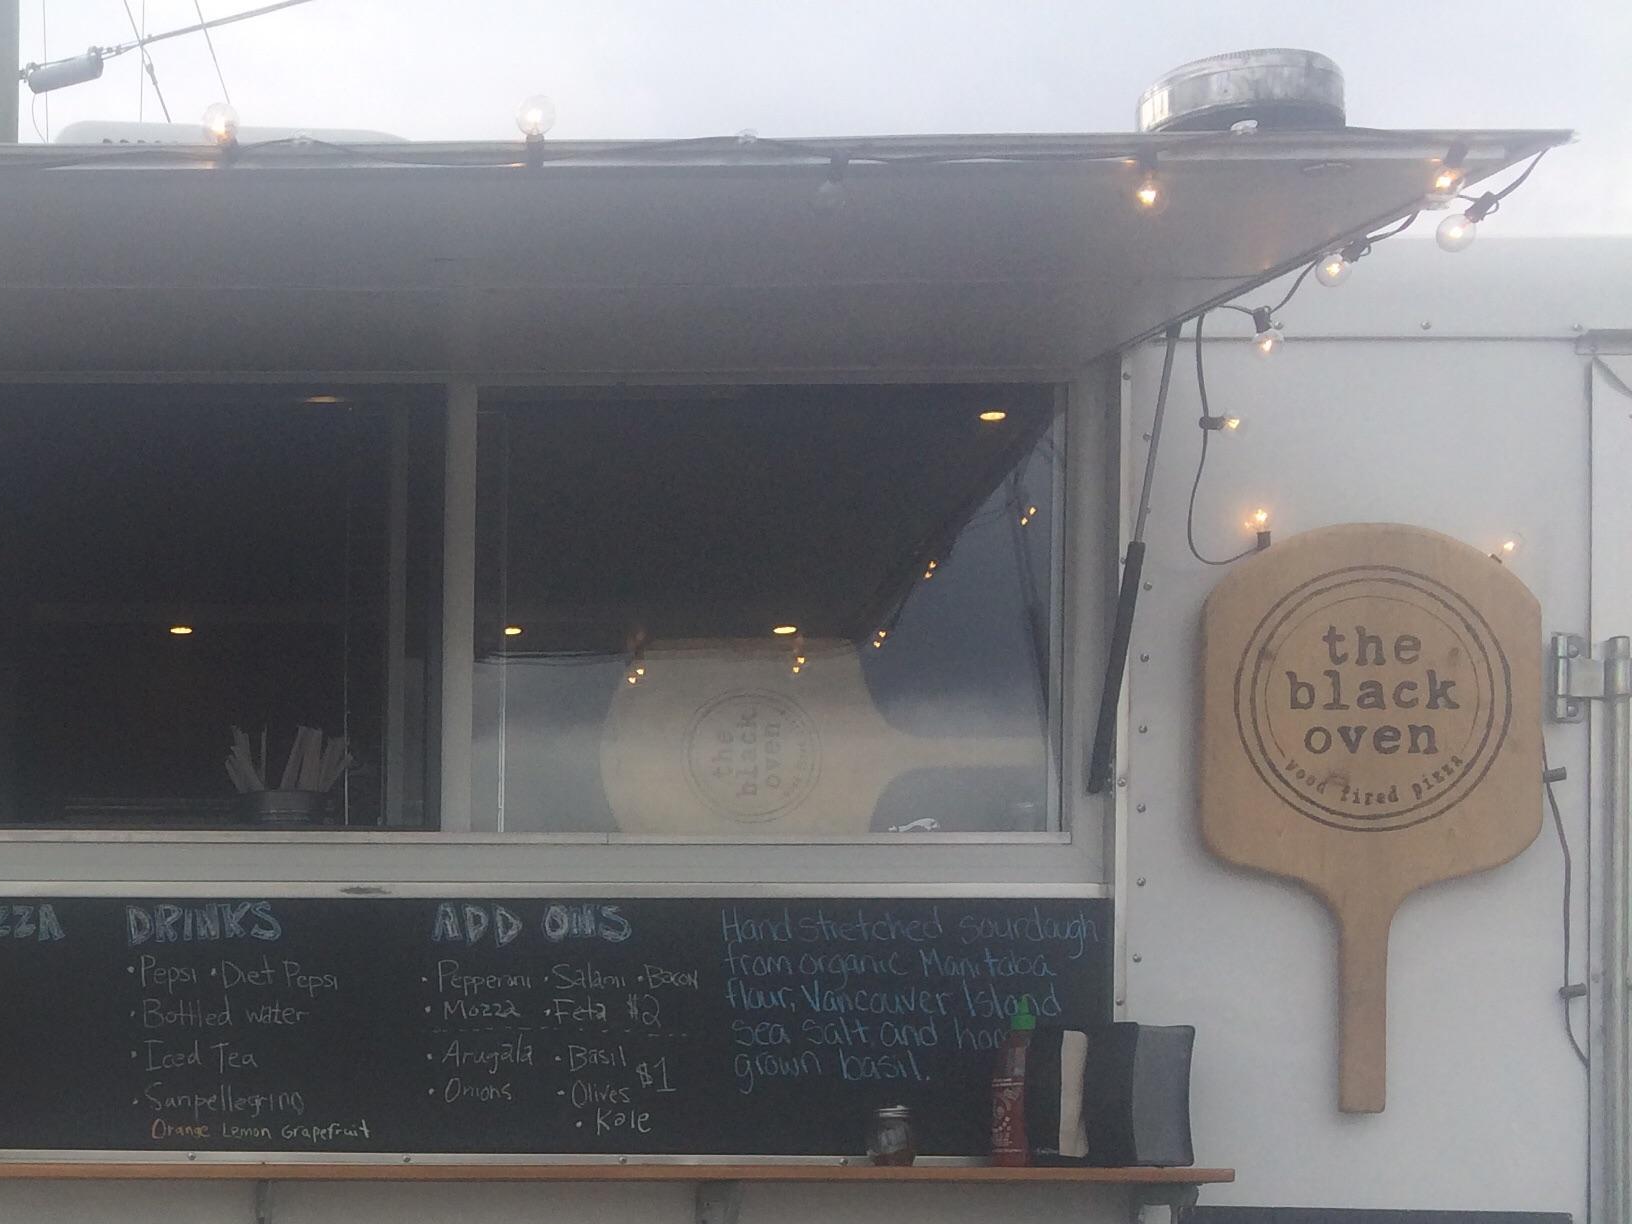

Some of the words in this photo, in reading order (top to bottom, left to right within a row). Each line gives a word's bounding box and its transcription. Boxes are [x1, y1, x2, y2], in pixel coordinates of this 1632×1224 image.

[1323, 625, 1421, 666] the
[1286, 670, 1460, 710] black
[1304, 723, 1439, 755] oven
[1285, 759, 1327, 794] wood
[1340, 784, 1399, 806] fired
[1412, 755, 1463, 800] pizza
[127, 901, 282, 945] DRINKS
[431, 903, 523, 948] ADD
[542, 903, 632, 942] ONS
[722, 907, 793, 944] Hand
[141, 955, 197, 995] Pepsi
[221, 954, 275, 989] Diet
[283, 960, 338, 997] Pepsi
[552, 962, 626, 989] Salami
[724, 942, 793, 977] from
[800, 952, 909, 991] organic
[143, 995, 233, 1028] Bottled
[553, 997, 607, 1024] Feta
[627, 993, 661, 1027] $2
[801, 979, 954, 1014] Vancouver
[962, 976, 1062, 1018] Island
[880, 1015, 938, 1047] and
[144, 1040, 202, 1071] Iced
[210, 1043, 258, 1073] Tea
[568, 1045, 627, 1072] Basil
[636, 1057, 676, 1092] $1
[734, 1051, 822, 1095] grown
[445, 1077, 512, 1103] Onions
[571, 1080, 630, 1109] Olives
[152, 1118, 211, 1140] Orange
[222, 1121, 272, 1139] Lemon
[282, 1119, 370, 1143] Grapefruit
[596, 1108, 652, 1136] Kale
